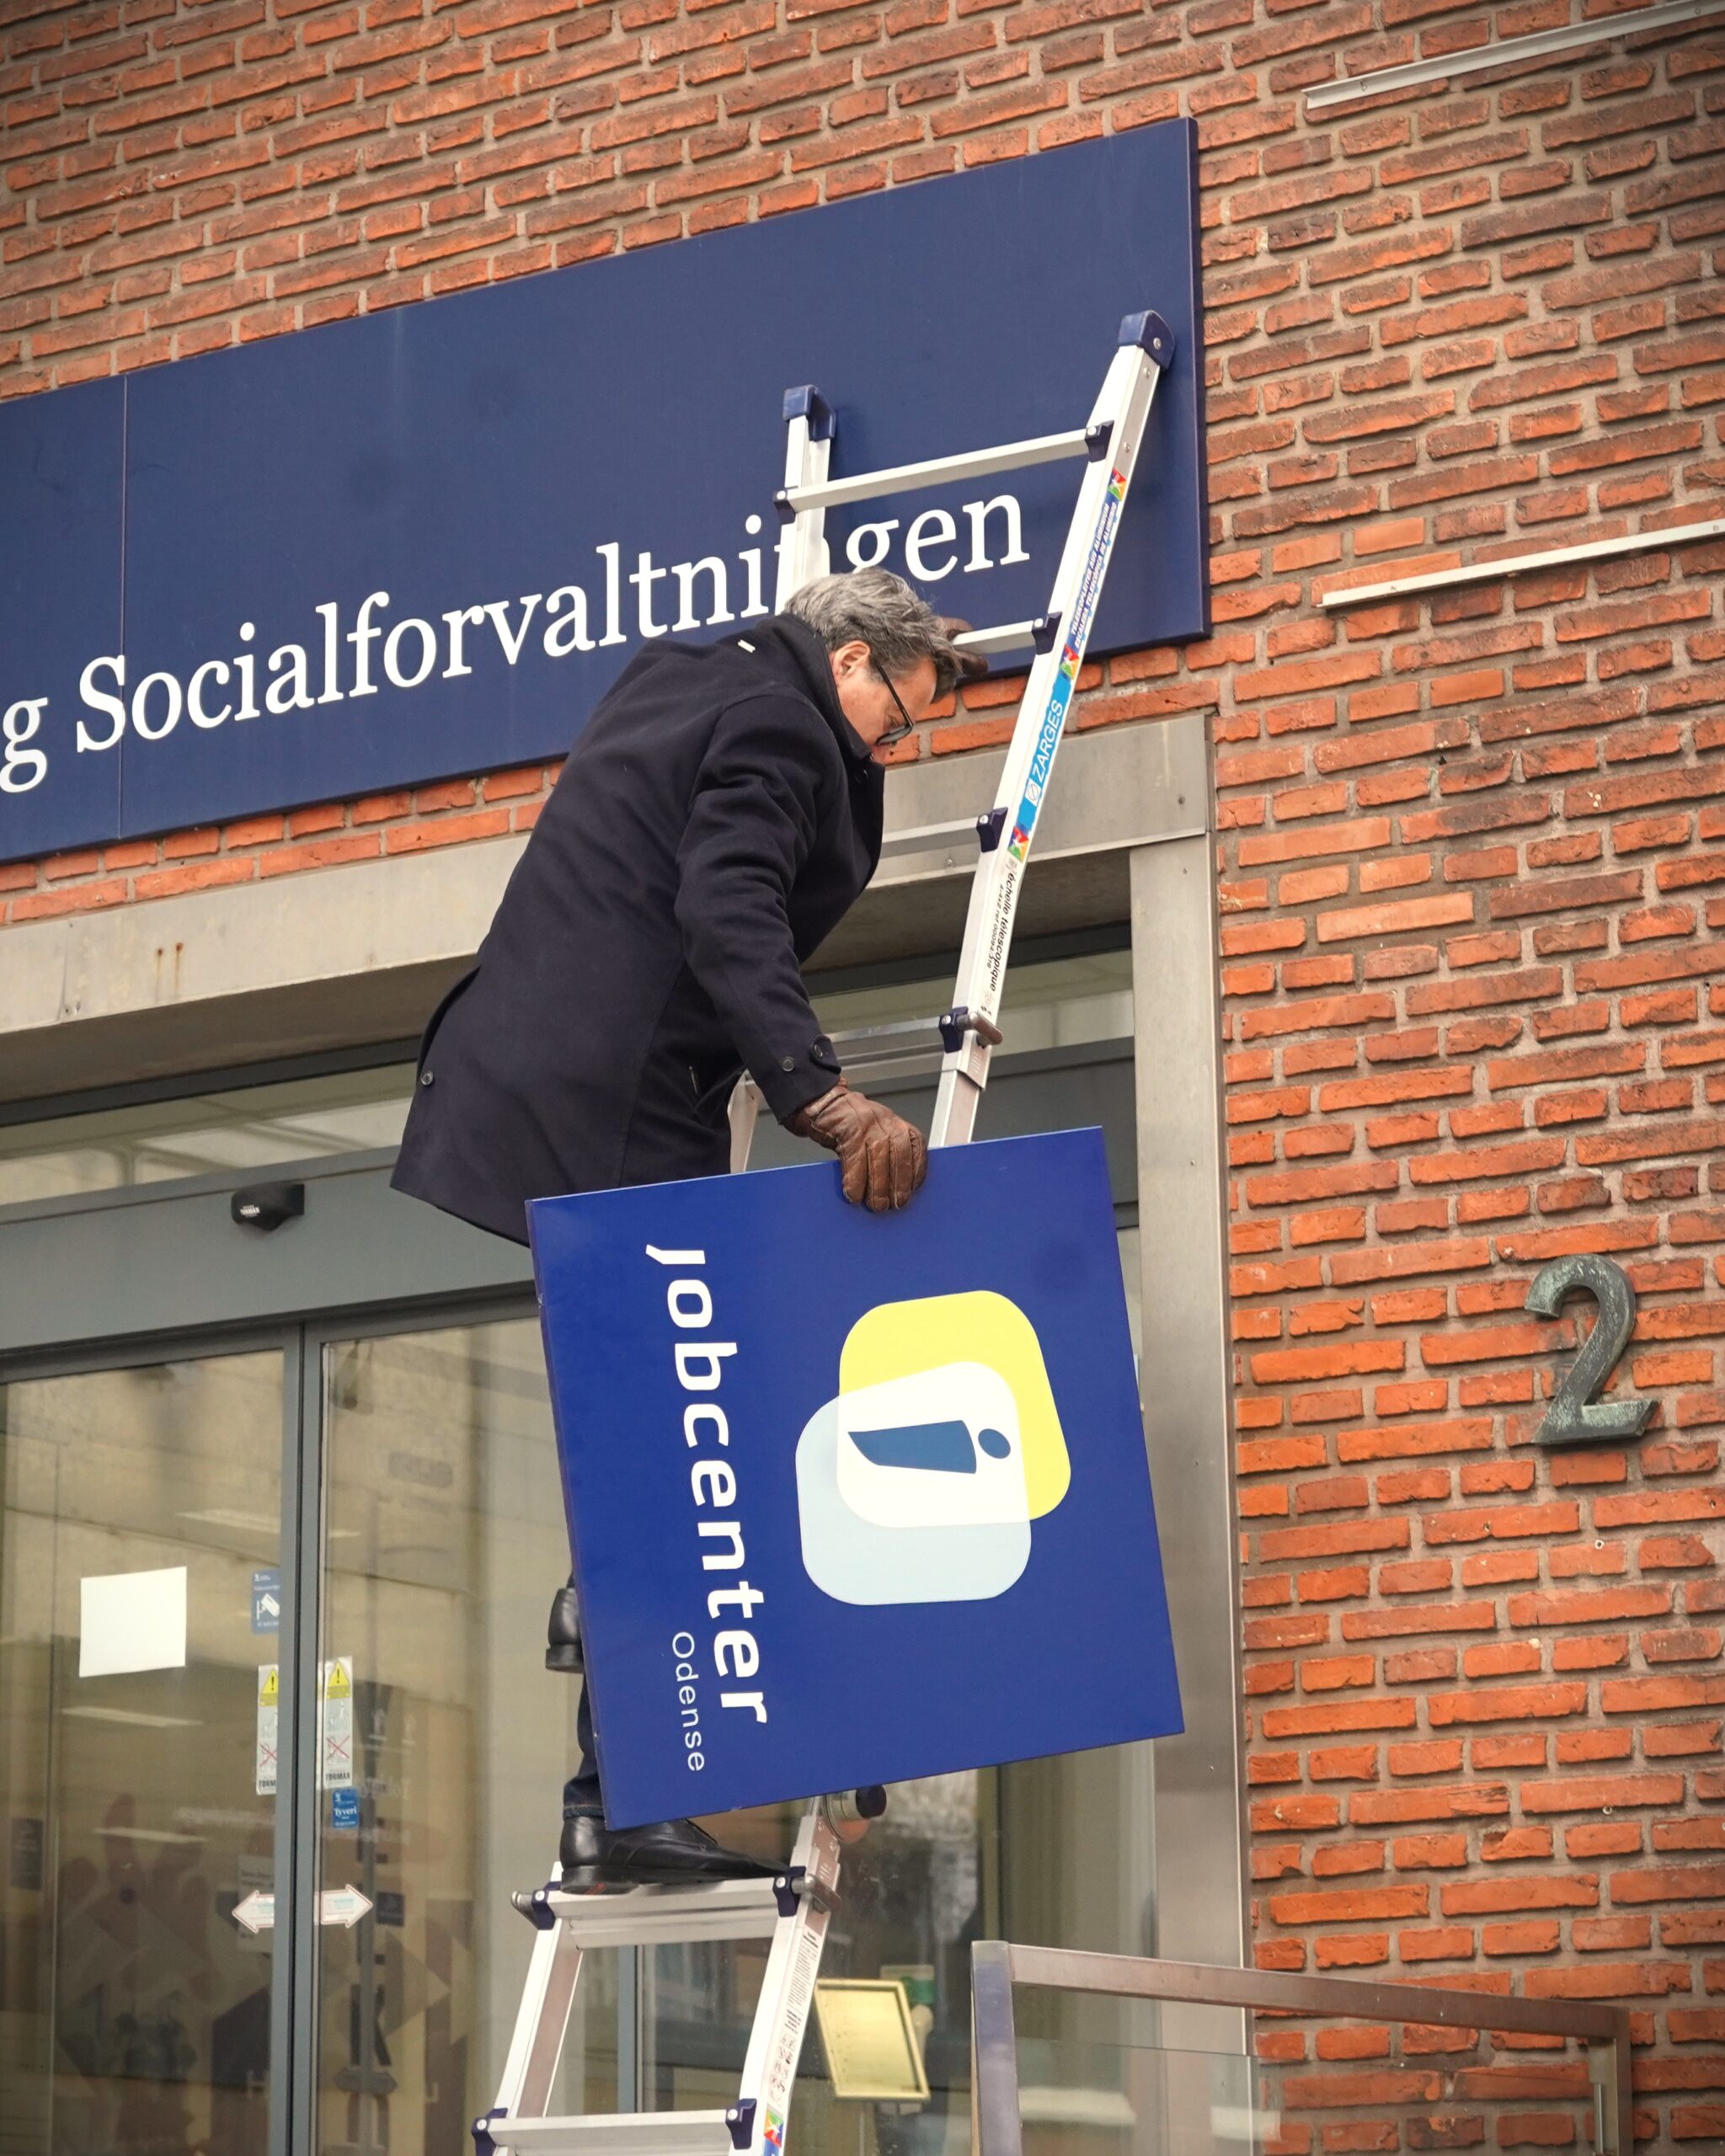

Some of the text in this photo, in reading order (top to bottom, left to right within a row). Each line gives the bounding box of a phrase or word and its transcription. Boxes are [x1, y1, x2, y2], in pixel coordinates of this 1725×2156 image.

[1094, 503, 1110, 552] ALUMINIUM
[76, 494, 1029, 752] Socialforvaltnigen
[1032, 700, 1063, 783] ZARGES
[990, 873, 1016, 992] échelle télescopique
[1524, 1252, 1659, 1444] 2
[671, 1630, 706, 1772] Odense
